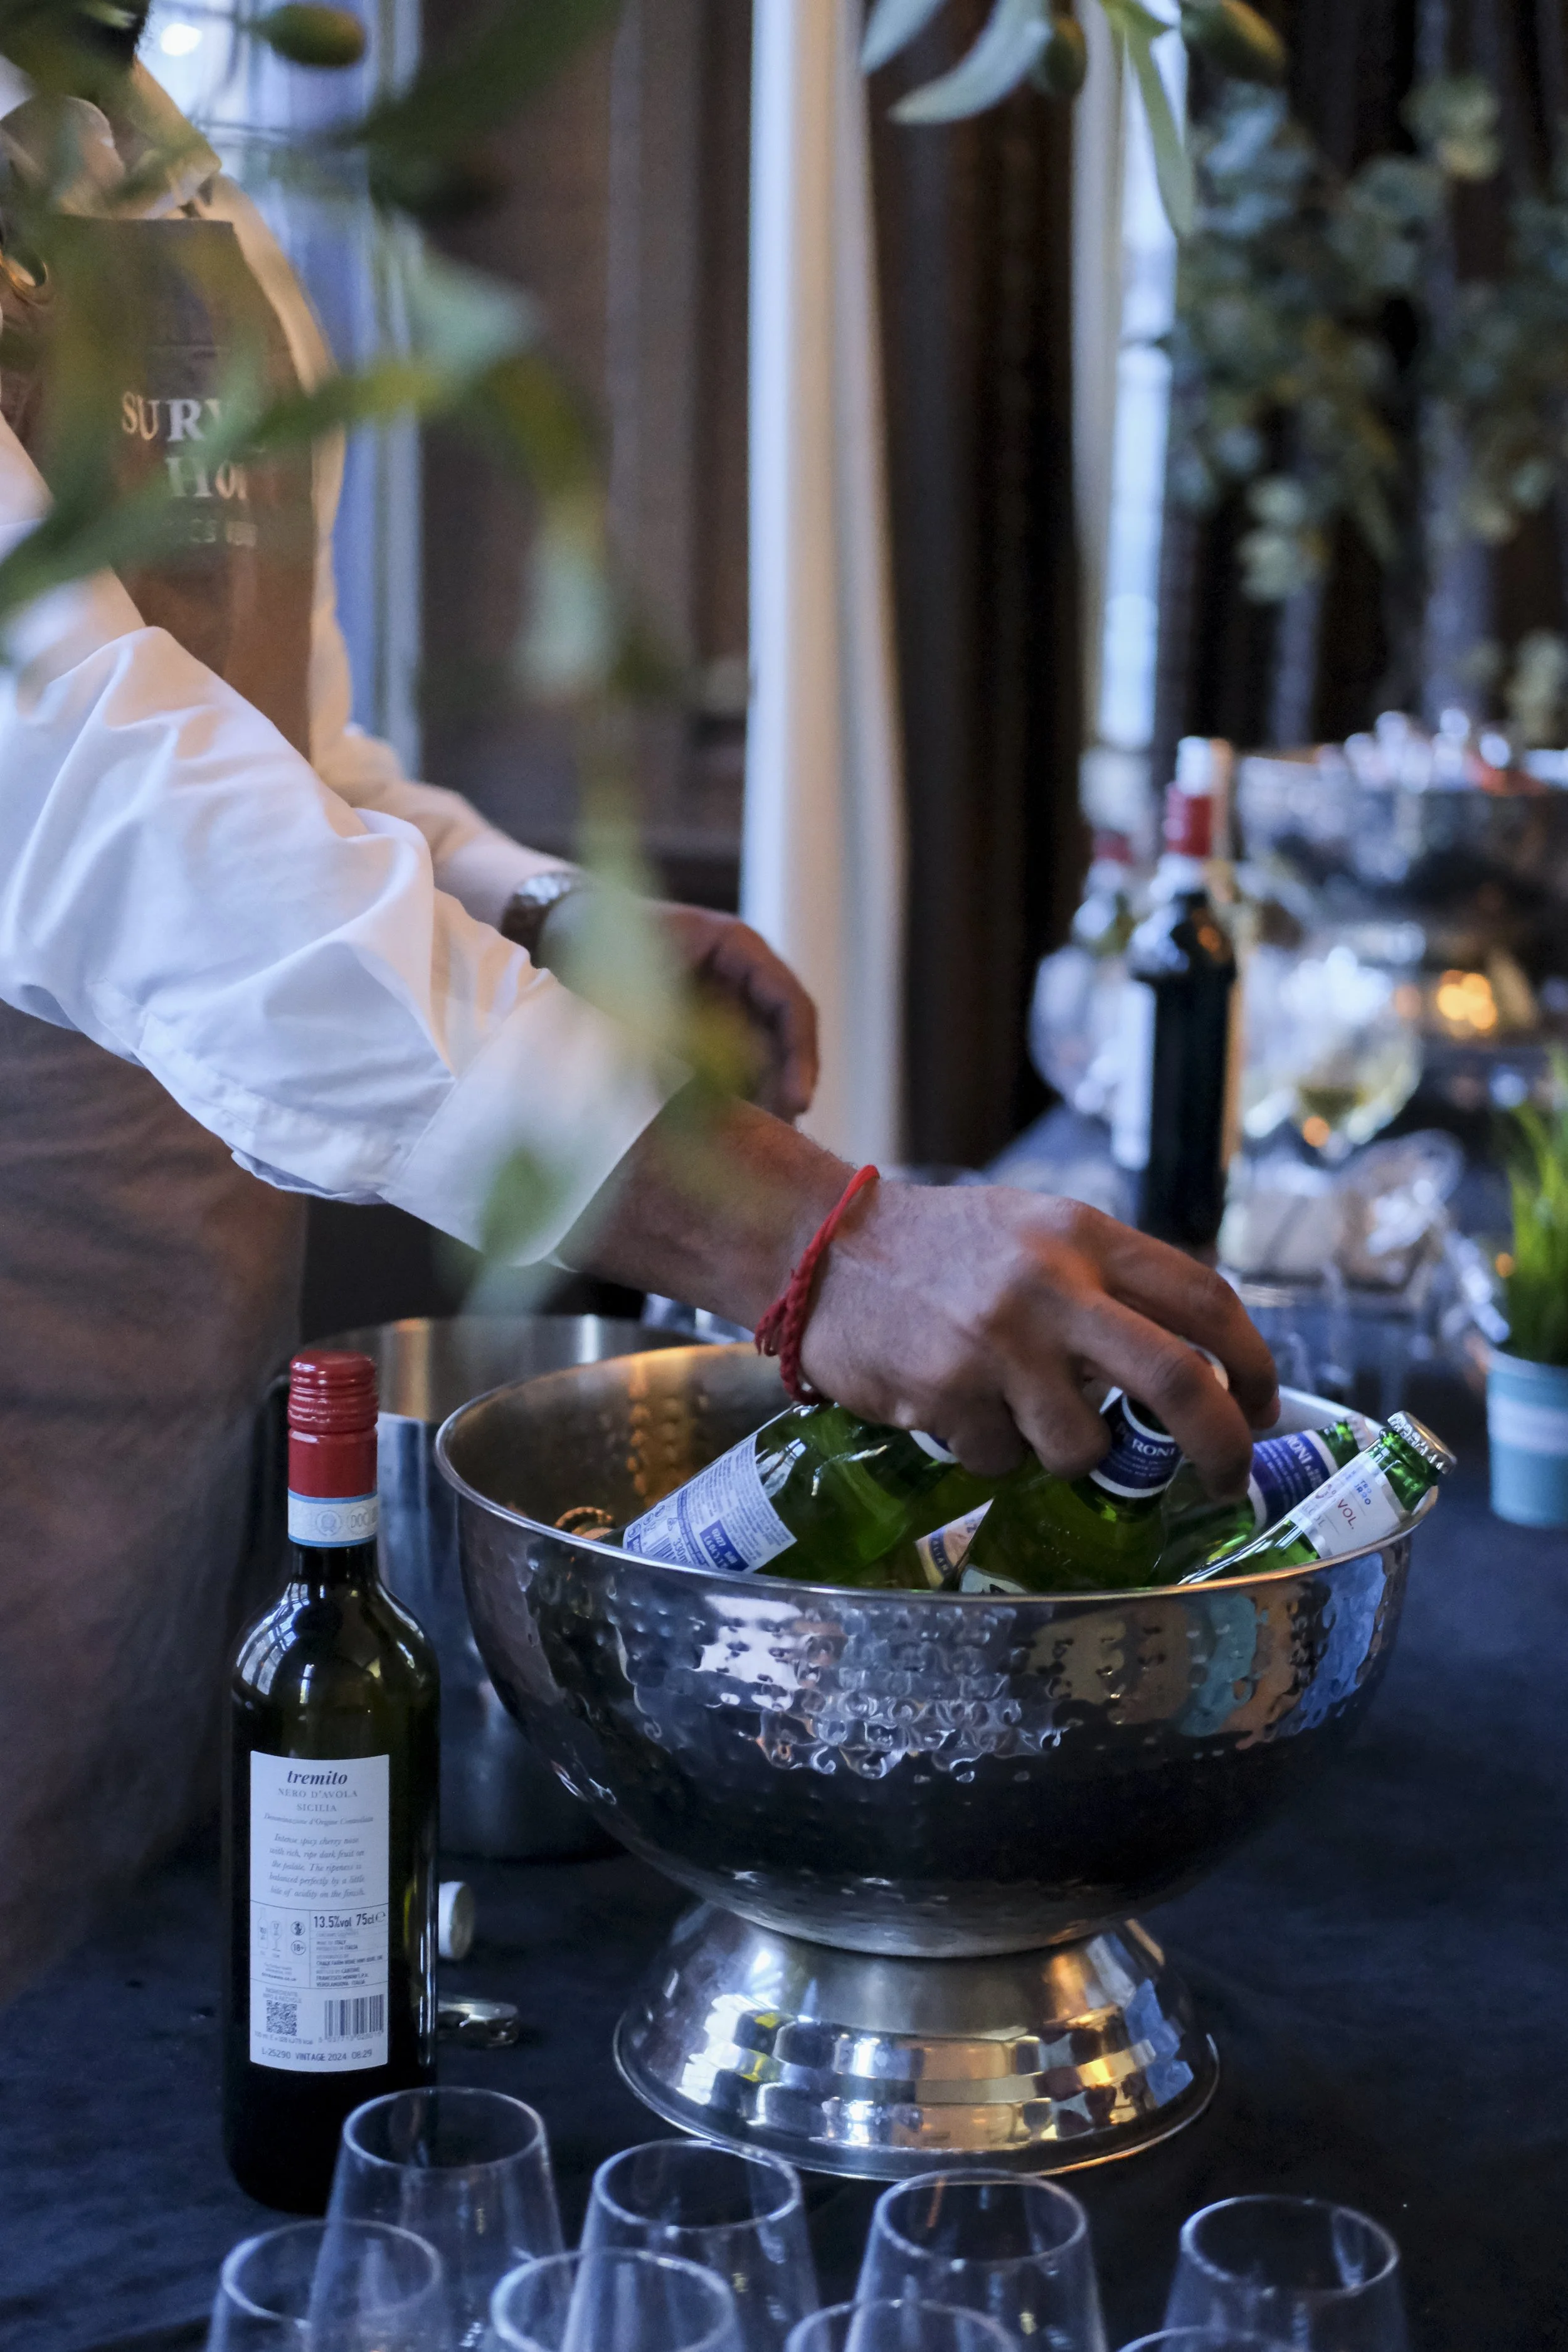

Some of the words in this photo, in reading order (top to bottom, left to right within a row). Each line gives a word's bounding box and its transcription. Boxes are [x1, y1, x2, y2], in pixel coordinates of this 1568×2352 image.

[1337, 1498, 1357, 1530] VOL.
[287, 1770, 348, 1785] tremito
[278, 1788, 306, 1798] NERO
[311, 1789, 358, 1798] D'AVOLA
[296, 1803, 337, 1812] SICILIA
[319, 1837, 342, 1846] cherry
[314, 1916, 351, 1928] 13.5%vol
[356, 1913, 374, 1926] 75cl
[295, 2052, 326, 2061] VINTAGE
[328, 2052, 347, 2061] 2024
